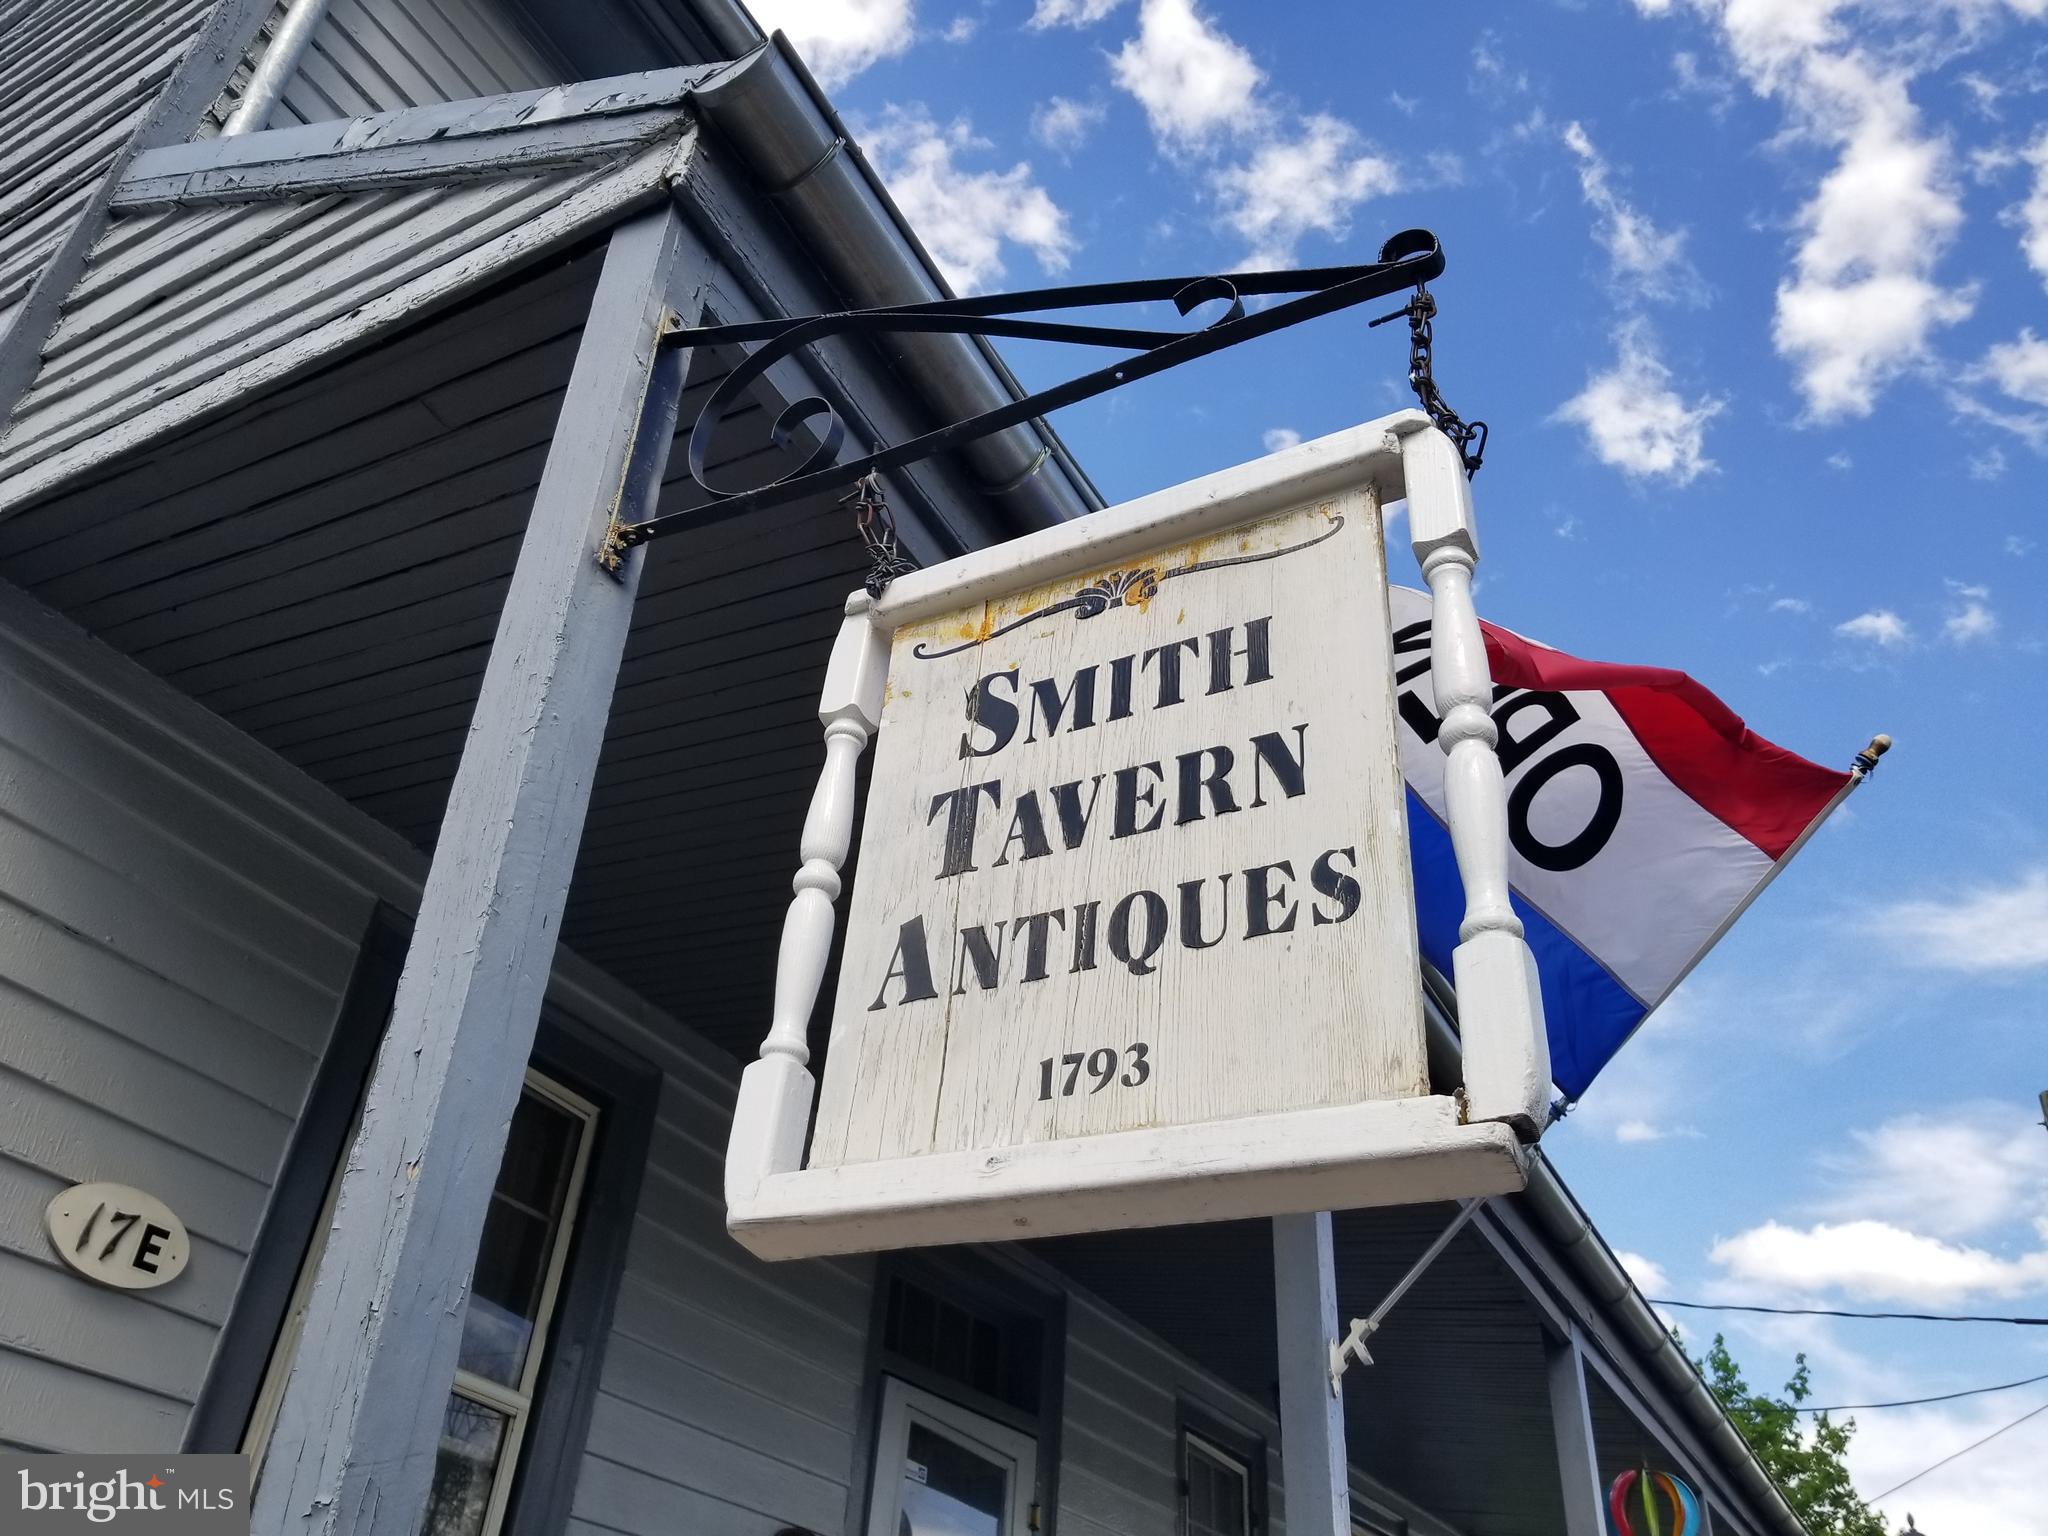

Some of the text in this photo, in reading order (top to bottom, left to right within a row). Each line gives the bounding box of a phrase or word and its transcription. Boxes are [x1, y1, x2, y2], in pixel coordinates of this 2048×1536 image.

[957, 614, 1275, 762] SMITH
[926, 722, 1310, 882] TAVERN
[866, 845, 1363, 1013] ANTIQUES
[1037, 1041, 1151, 1101] 1793
[75, 1202, 171, 1274] 17E
